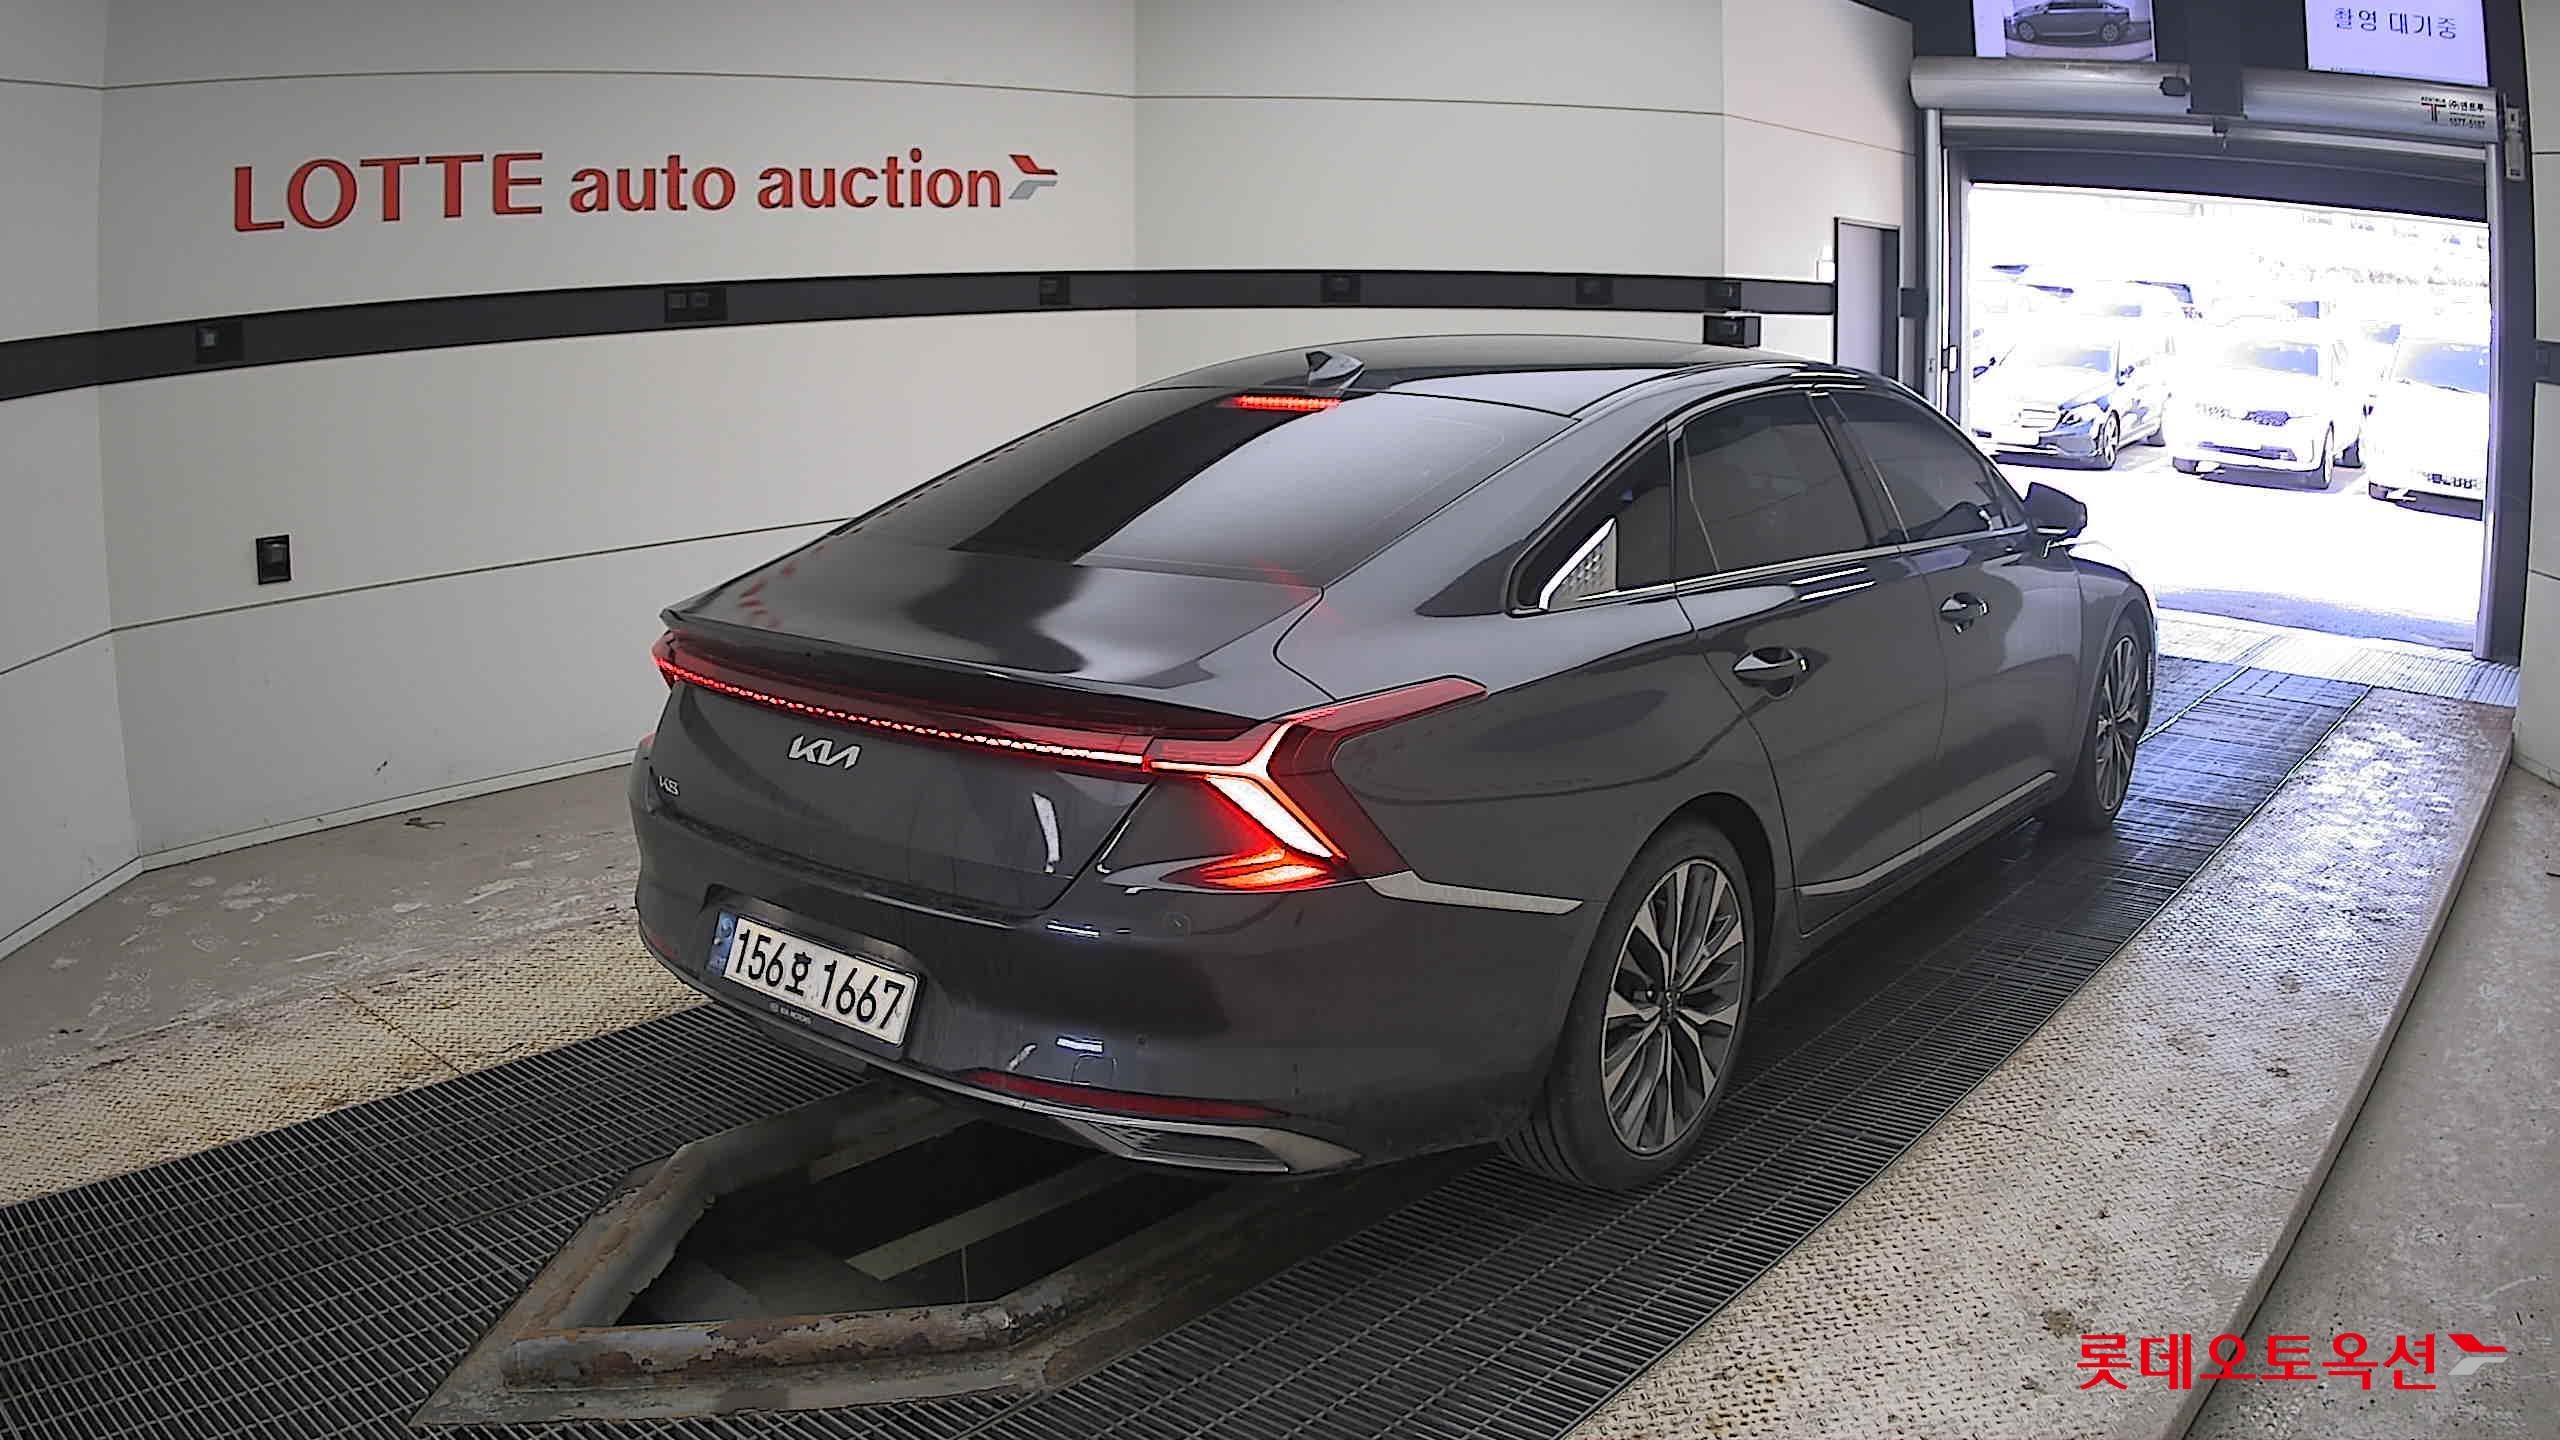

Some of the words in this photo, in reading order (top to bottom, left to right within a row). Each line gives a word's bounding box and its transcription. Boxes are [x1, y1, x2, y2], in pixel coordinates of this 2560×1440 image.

[2335, 6, 2378, 33] 촬영
[2388, 11, 2458, 41] 대기중
[233, 151, 545, 233] LOTTE
[568, 154, 737, 213] auto
[756, 147, 1002, 210] auction
[787, 735, 863, 770] KIA
[735, 928, 813, 997] 156호
[820, 959, 907, 1030] 1667
